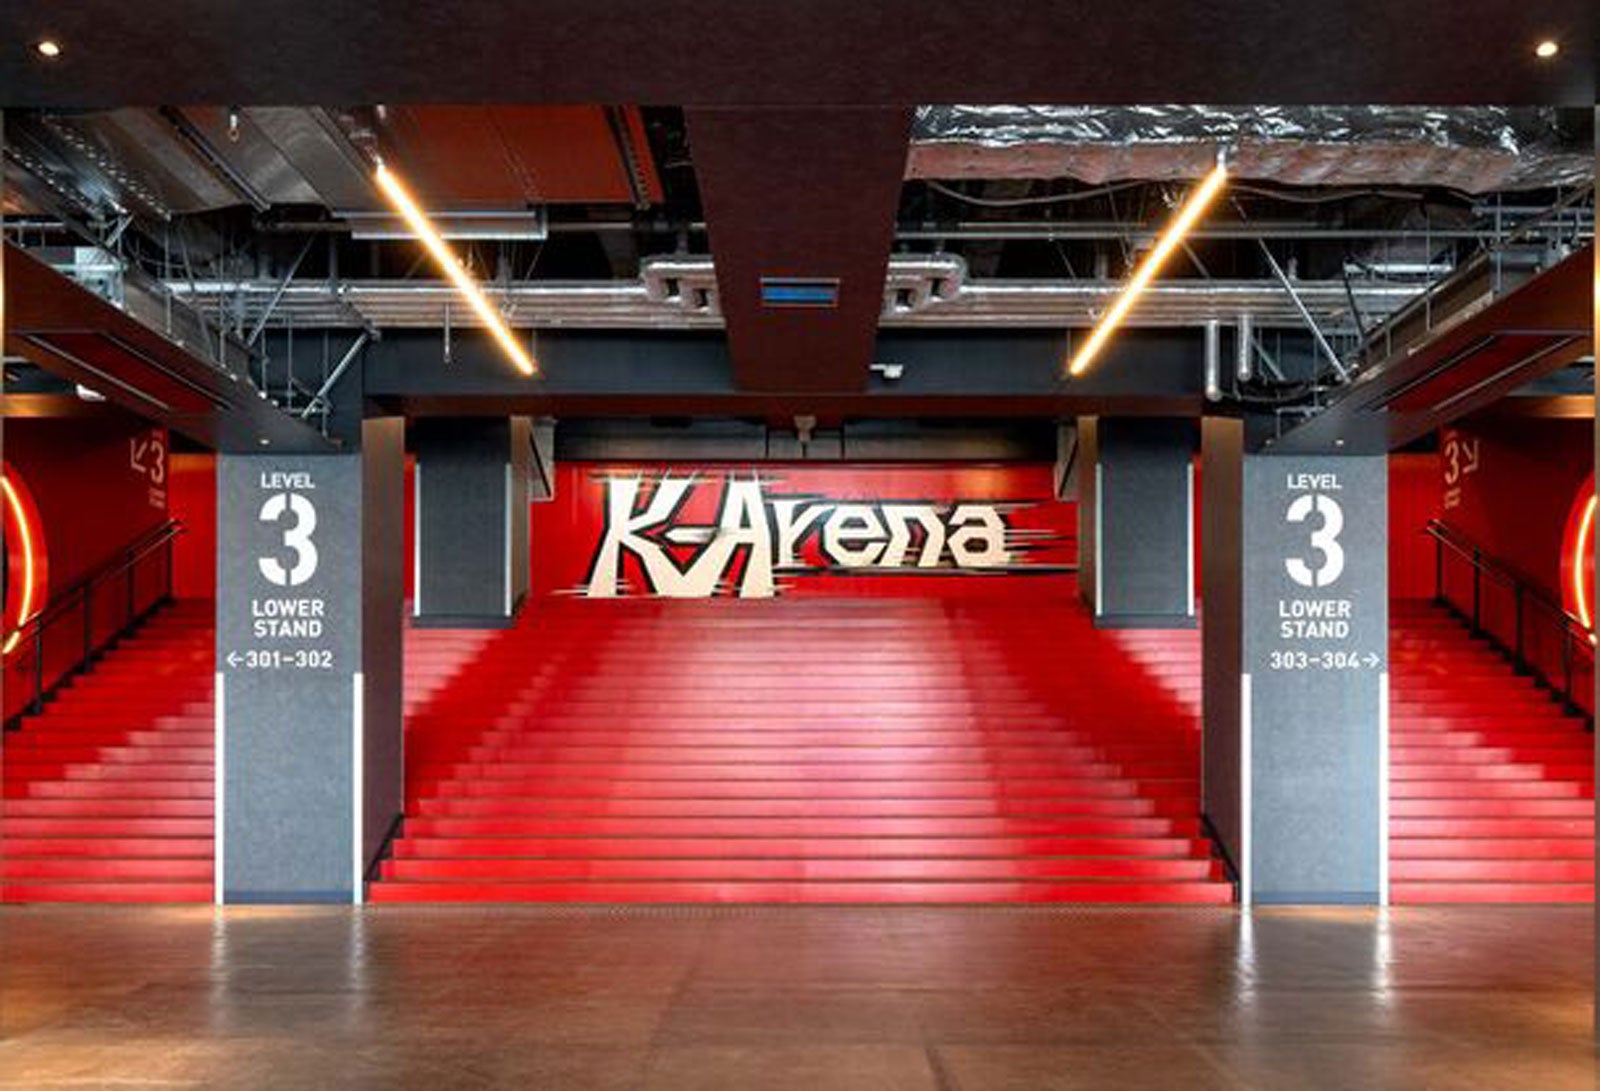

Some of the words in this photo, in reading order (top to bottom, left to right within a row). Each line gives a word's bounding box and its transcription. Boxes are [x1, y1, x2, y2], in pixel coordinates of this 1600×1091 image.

[260, 472, 315, 489] LEVEL
[1286, 473, 1343, 490] LEVEL
[258, 492, 319, 587] 3
[583, 468, 1013, 598] K-Arena
[1285, 493, 1345, 588] 3
[251, 599, 324, 618] LOWER
[1278, 600, 1352, 619] LOWER
[253, 620, 322, 638] STAND
[1280, 620, 1349, 639] STAND
